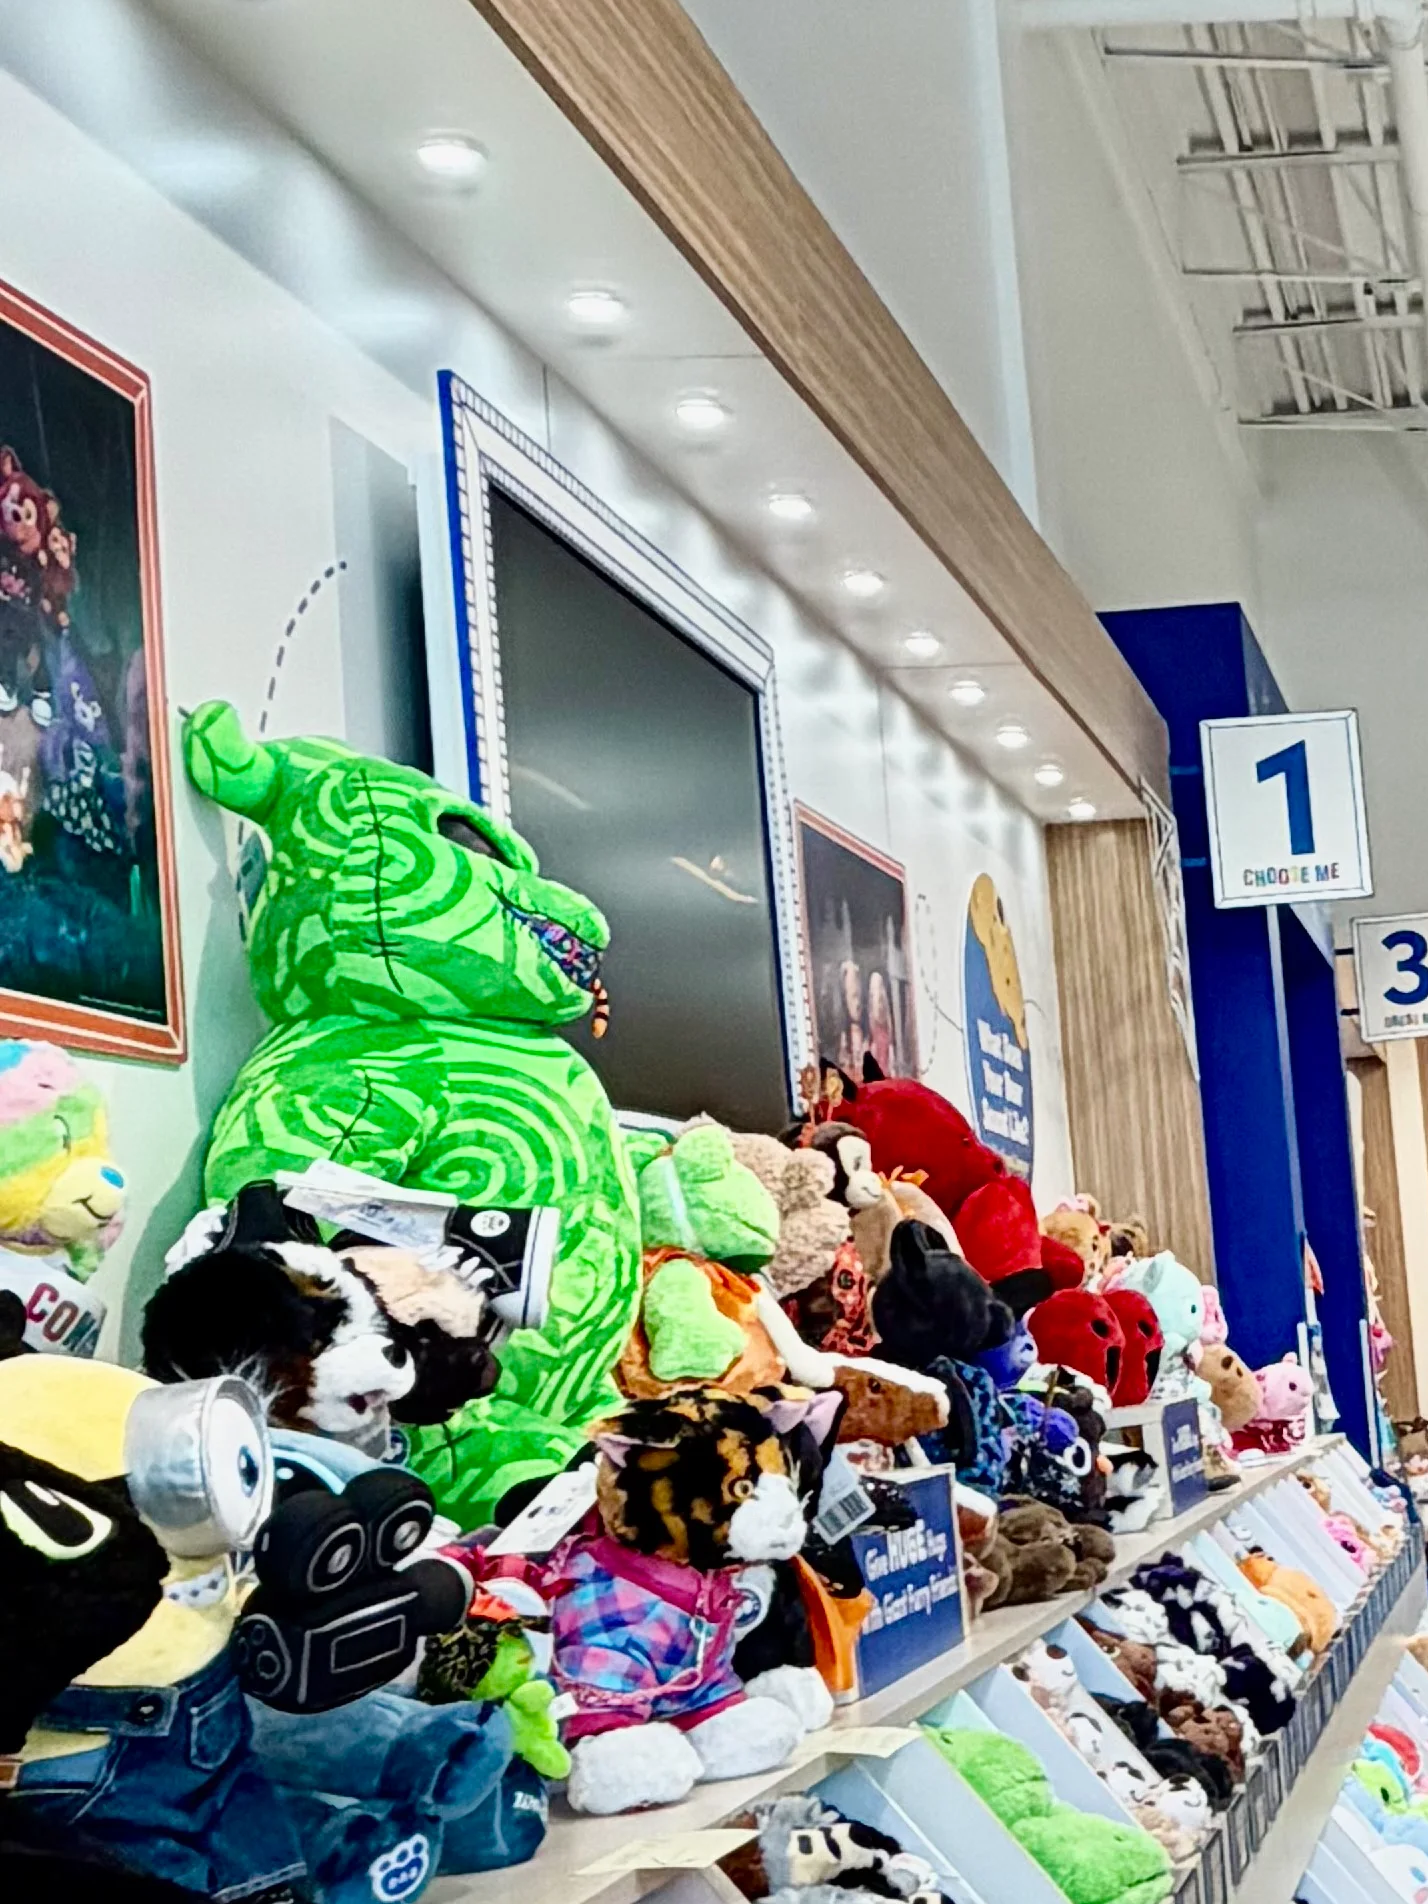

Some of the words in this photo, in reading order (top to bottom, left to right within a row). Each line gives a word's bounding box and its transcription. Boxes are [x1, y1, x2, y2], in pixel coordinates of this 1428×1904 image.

[1256, 740, 1316, 855] 1
[1243, 865, 1310, 887] CHOOSE
[1314, 862, 1340, 882] ME
